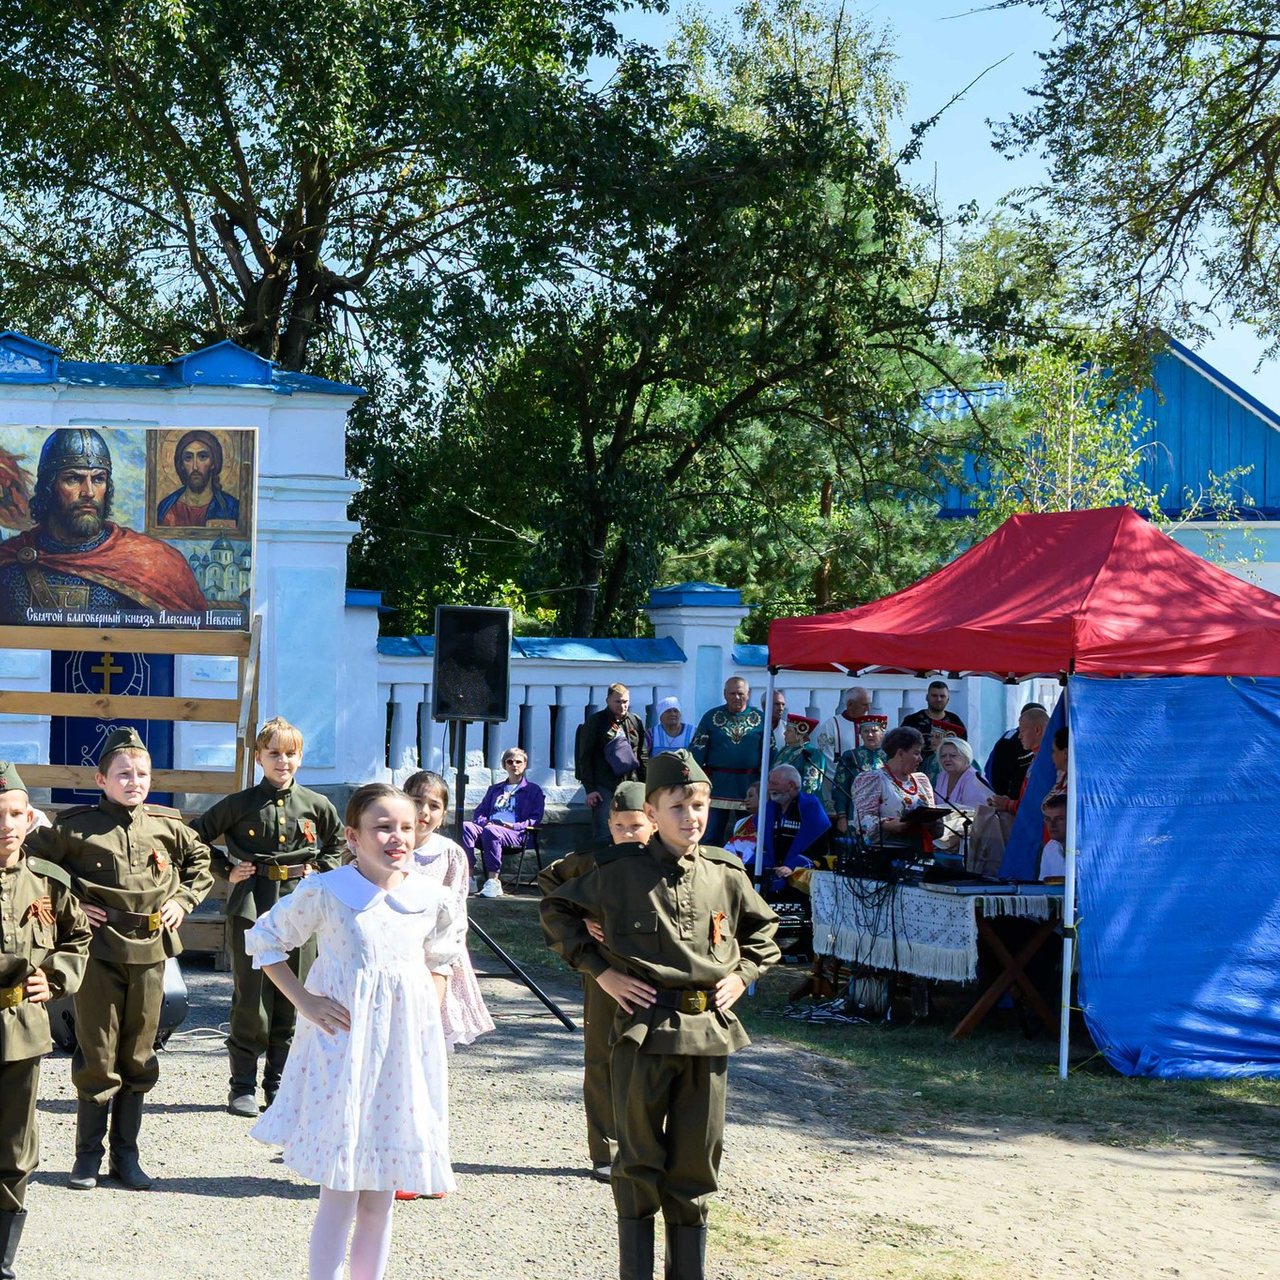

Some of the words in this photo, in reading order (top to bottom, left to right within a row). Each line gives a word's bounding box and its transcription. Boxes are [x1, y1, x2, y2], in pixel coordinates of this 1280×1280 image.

[66, 610, 121, 629] благоверный
[124, 614, 155, 627] князь
[158, 609, 202, 630] Александр
[205, 610, 242, 626] Невский
